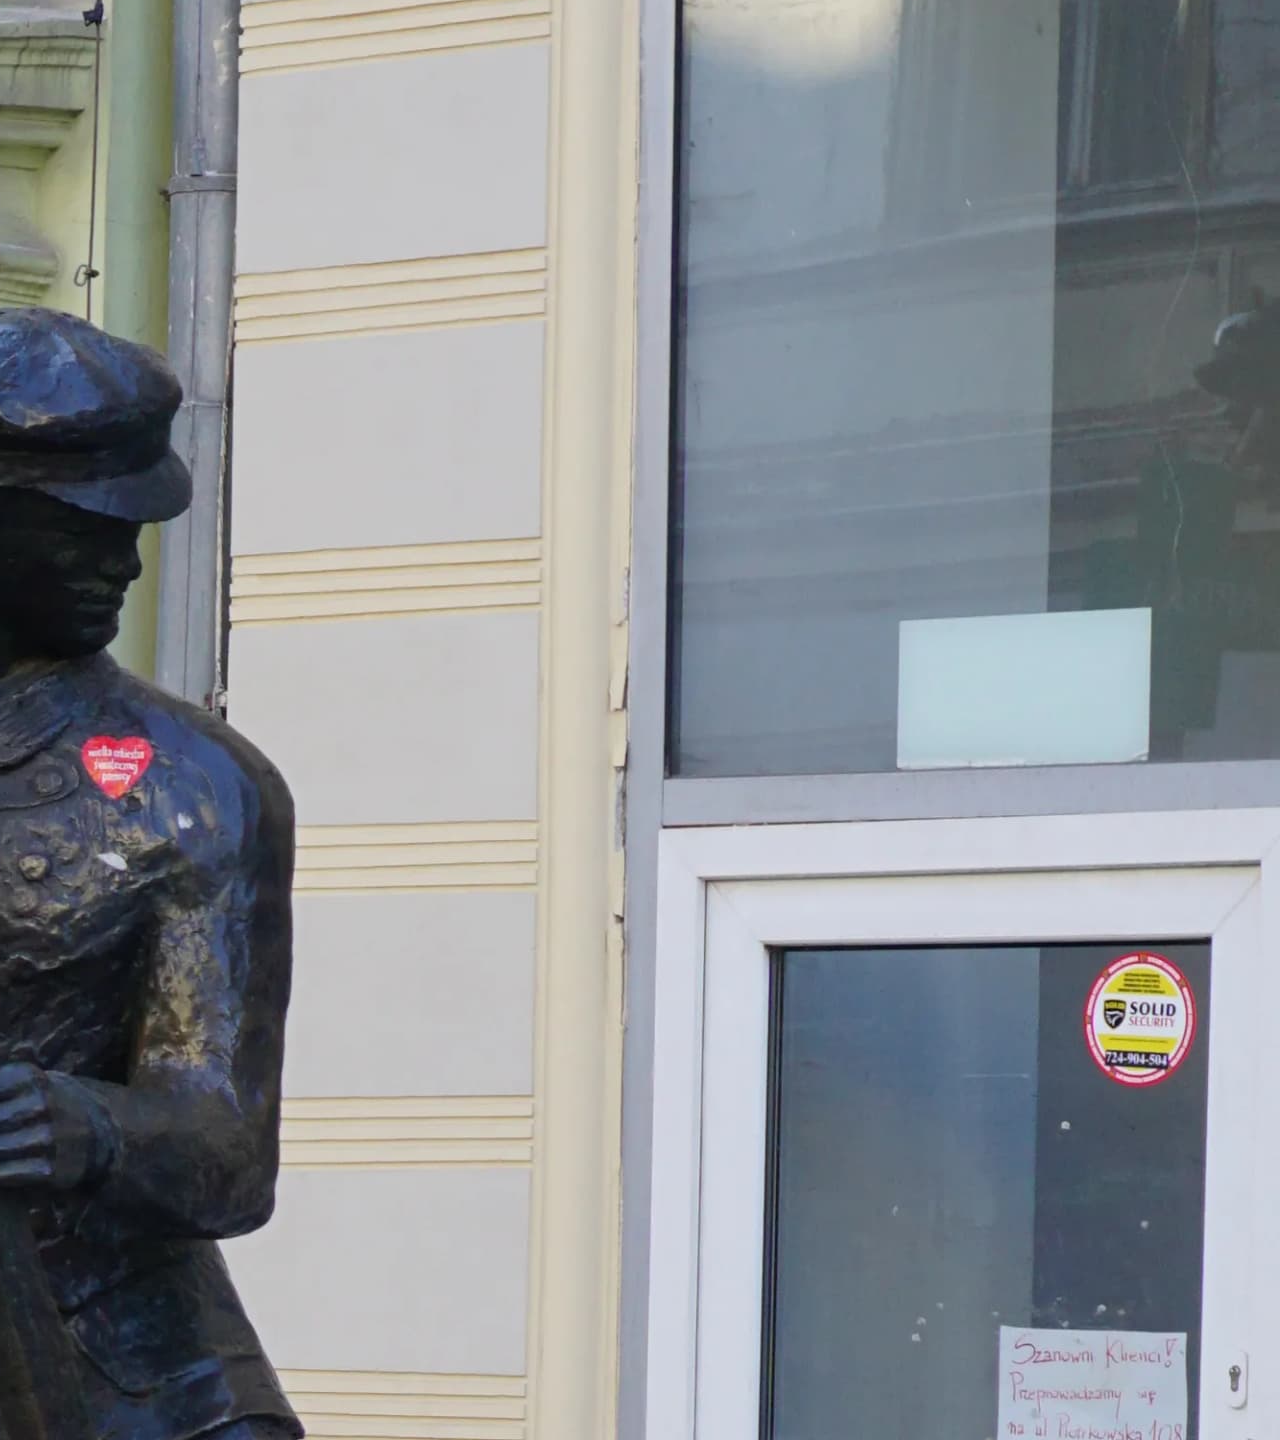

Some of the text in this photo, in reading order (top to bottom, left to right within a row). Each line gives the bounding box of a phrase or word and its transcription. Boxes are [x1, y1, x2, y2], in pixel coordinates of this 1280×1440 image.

[1129, 1001, 1177, 1017] SOLID
[1128, 1015, 1176, 1029] SECURITY
[1106, 1051, 1168, 1067] 724-904-504
[1011, 1333, 1094, 1365] Szanowni
[1008, 1420, 1025, 1435] na
